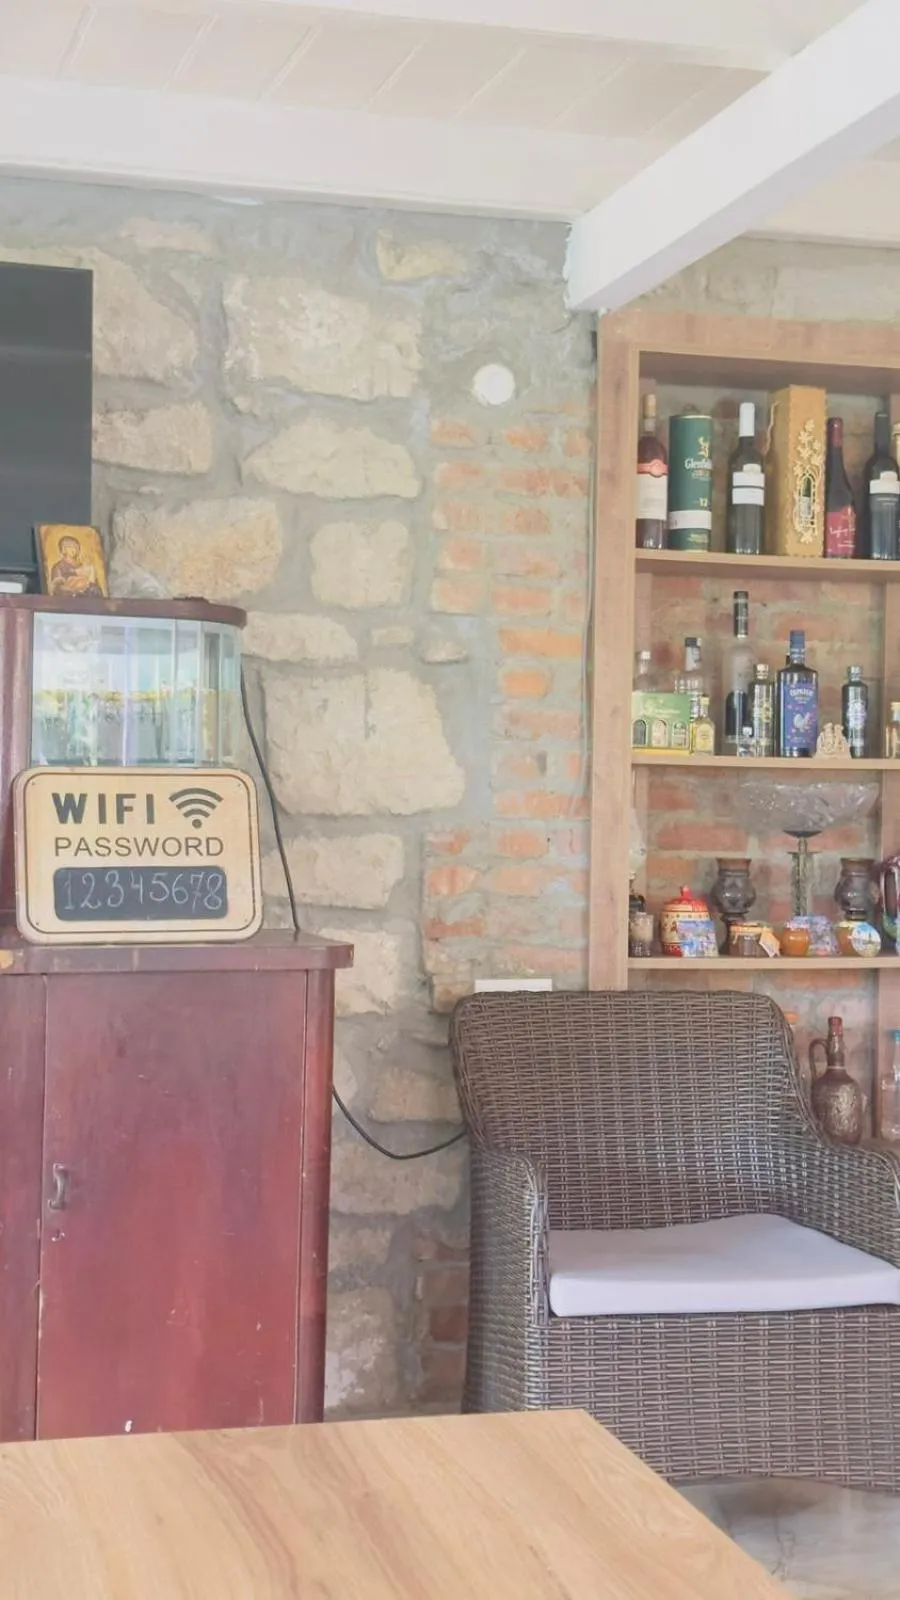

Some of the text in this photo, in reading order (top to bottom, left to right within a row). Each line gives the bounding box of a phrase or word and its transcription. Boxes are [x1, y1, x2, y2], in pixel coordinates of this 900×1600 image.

[51, 792, 156, 825] WIFI
[54, 836, 224, 857] PASSWORD
[63, 869, 223, 913] 12345678
